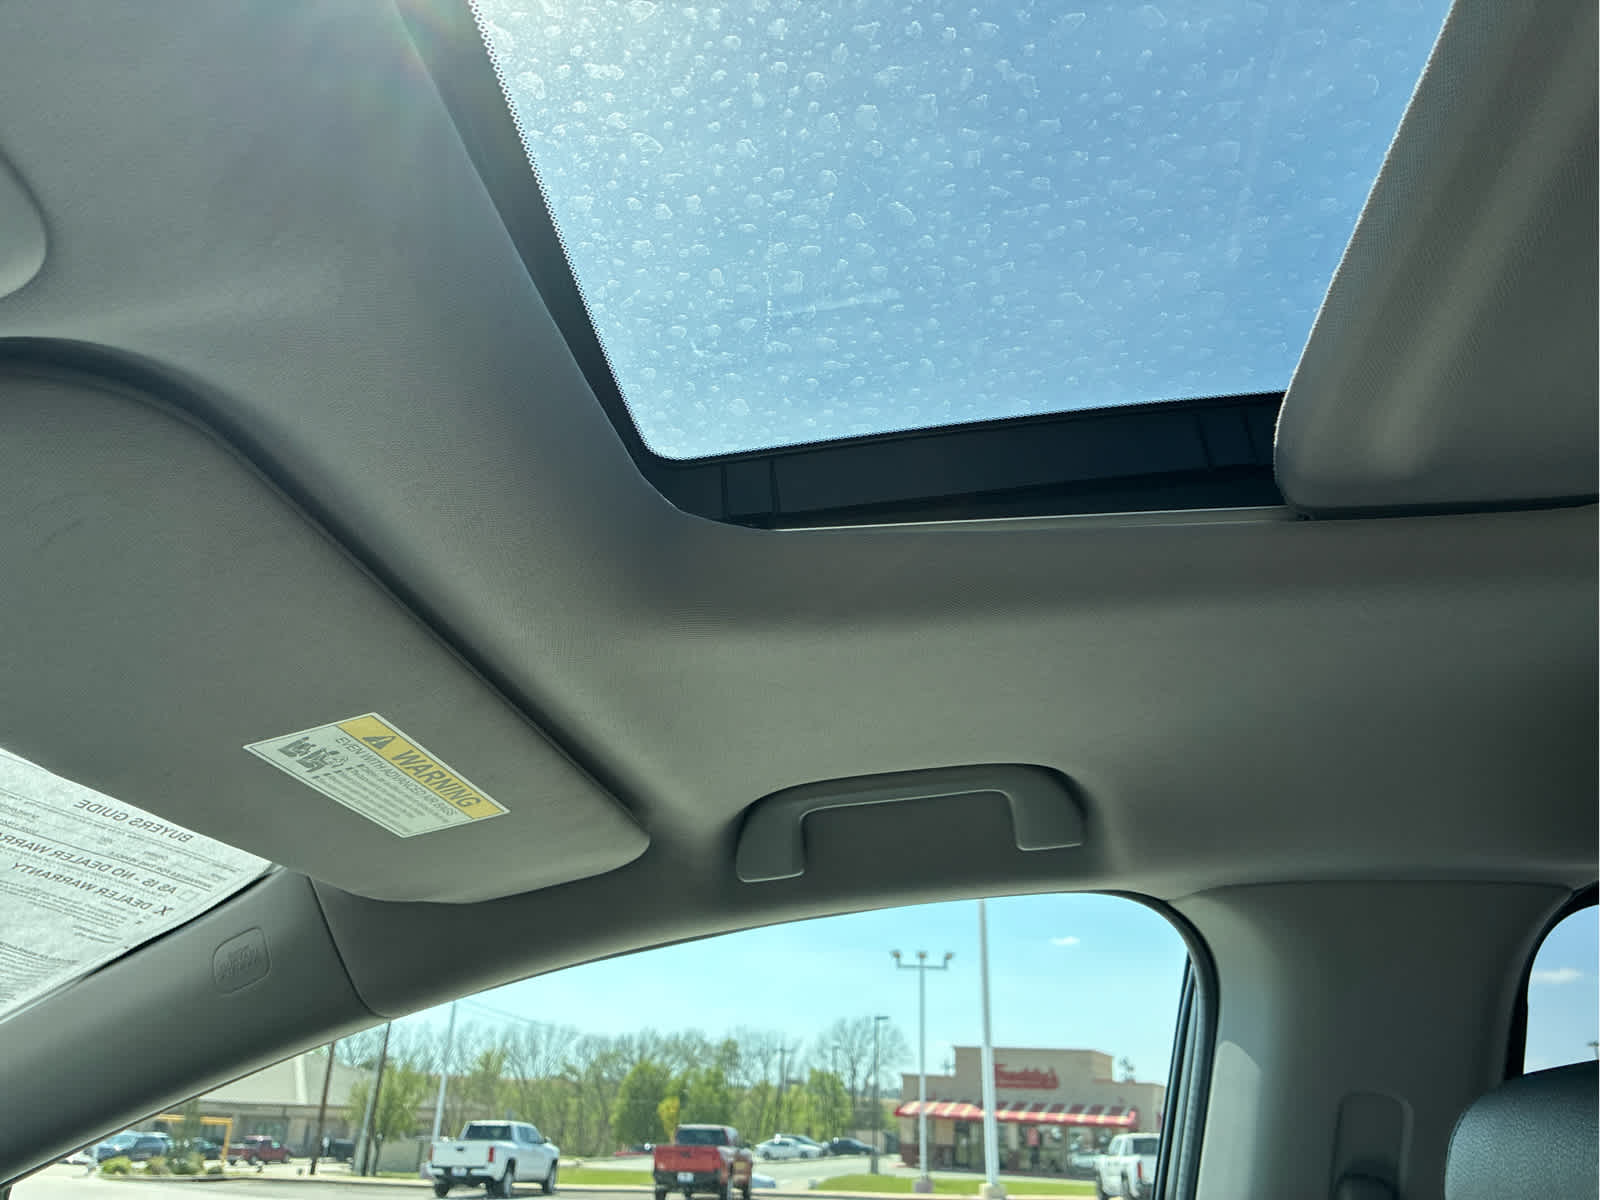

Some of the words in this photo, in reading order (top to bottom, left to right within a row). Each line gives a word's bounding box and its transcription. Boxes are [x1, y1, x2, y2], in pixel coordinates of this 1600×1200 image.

[335, 736, 365, 755] EVEN
[359, 752, 387, 769] WITH
[382, 766, 427, 795] ADVANCED
[392, 750, 481, 807] WARNING
